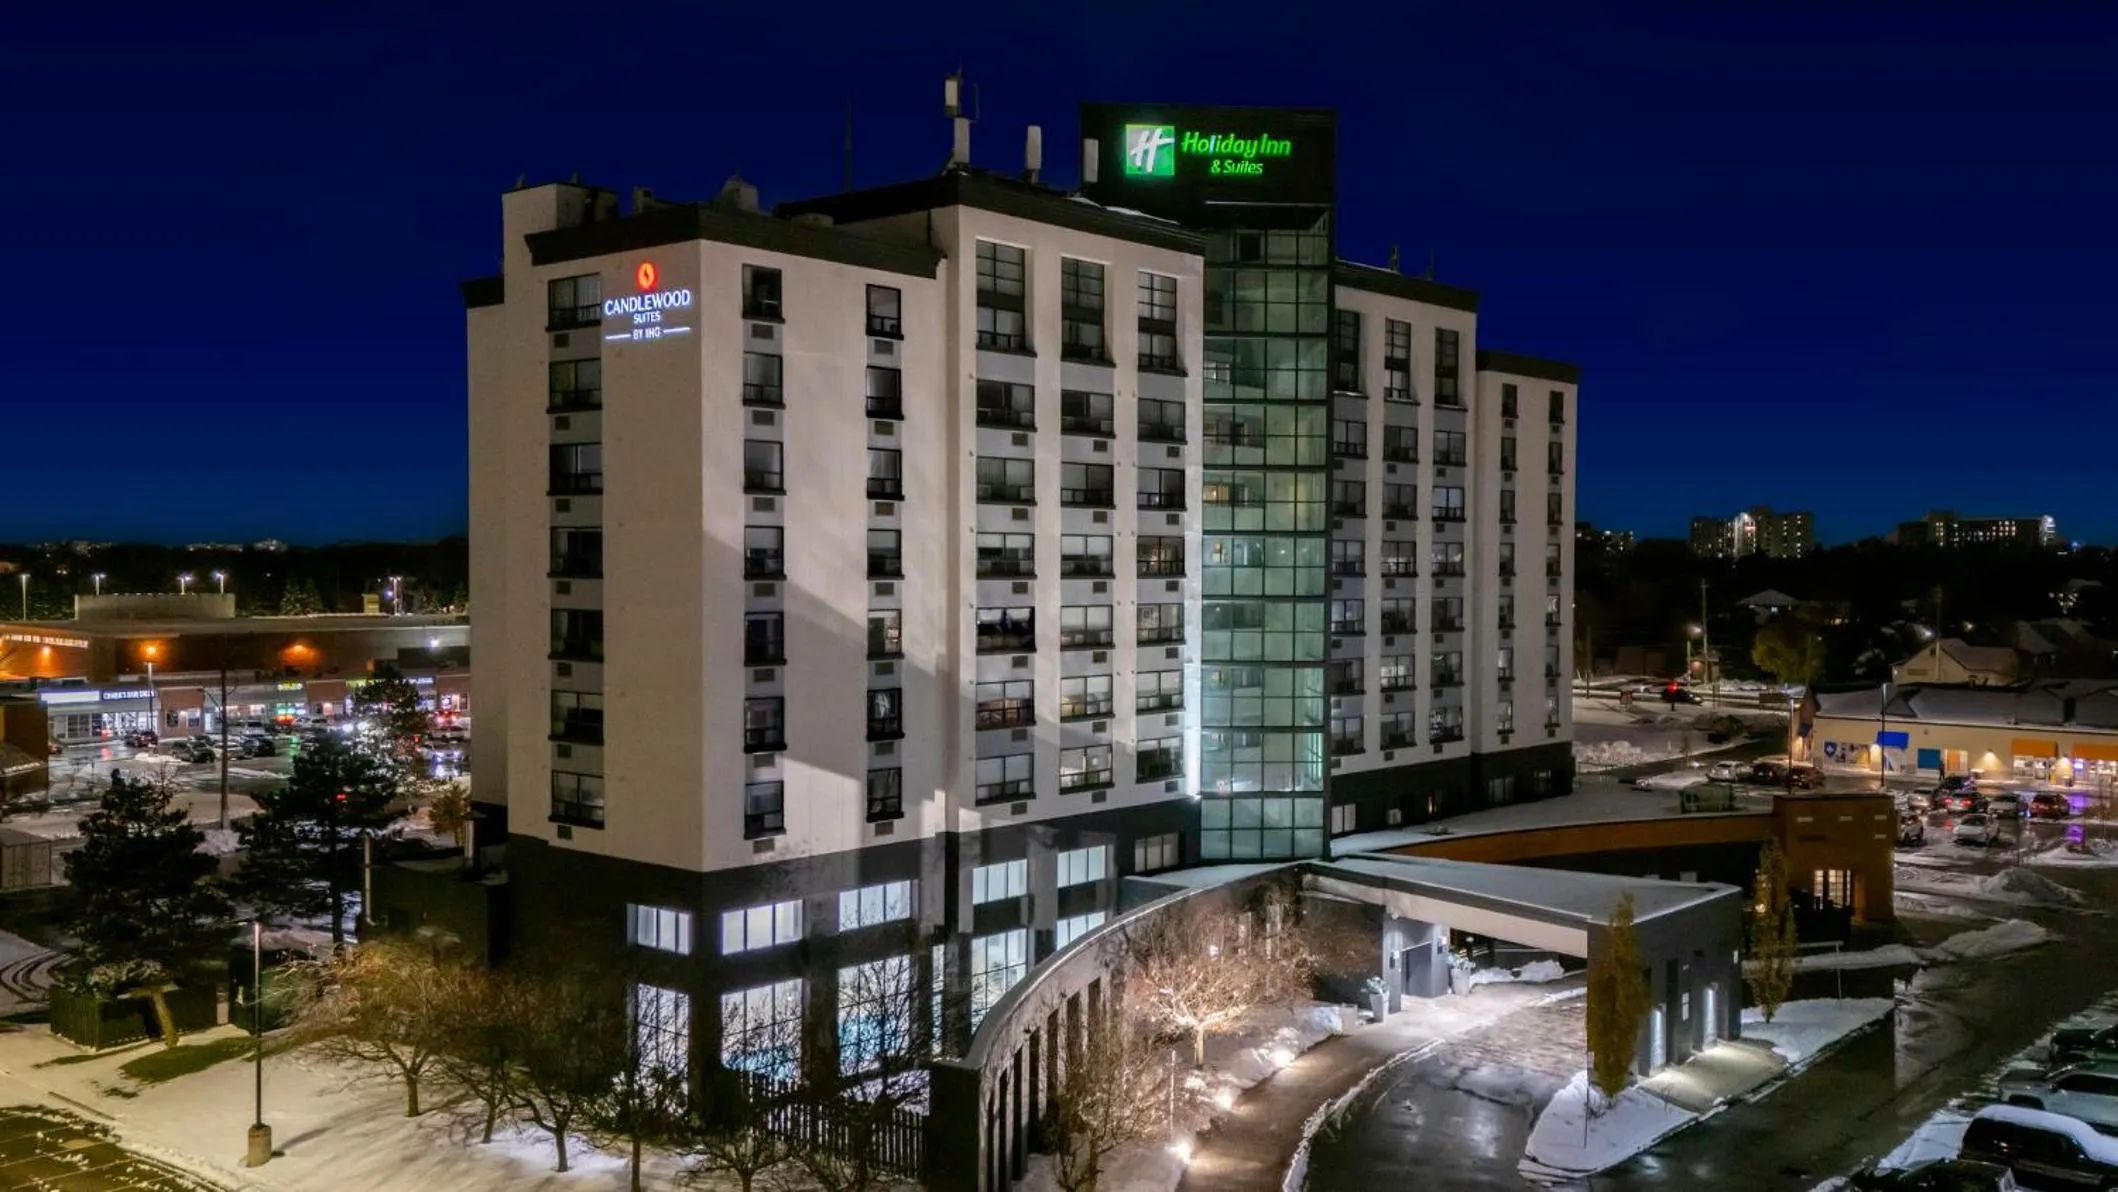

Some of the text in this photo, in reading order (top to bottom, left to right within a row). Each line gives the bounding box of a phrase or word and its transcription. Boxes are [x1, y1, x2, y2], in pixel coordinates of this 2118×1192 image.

[1181, 132, 1291, 158] Holiday Inn
[1211, 160, 1264, 174] & Suites
[604, 289, 690, 316] CANDLEWOOD
[633, 311, 661, 324] SUITES
[633, 327, 661, 340] BY IHG
